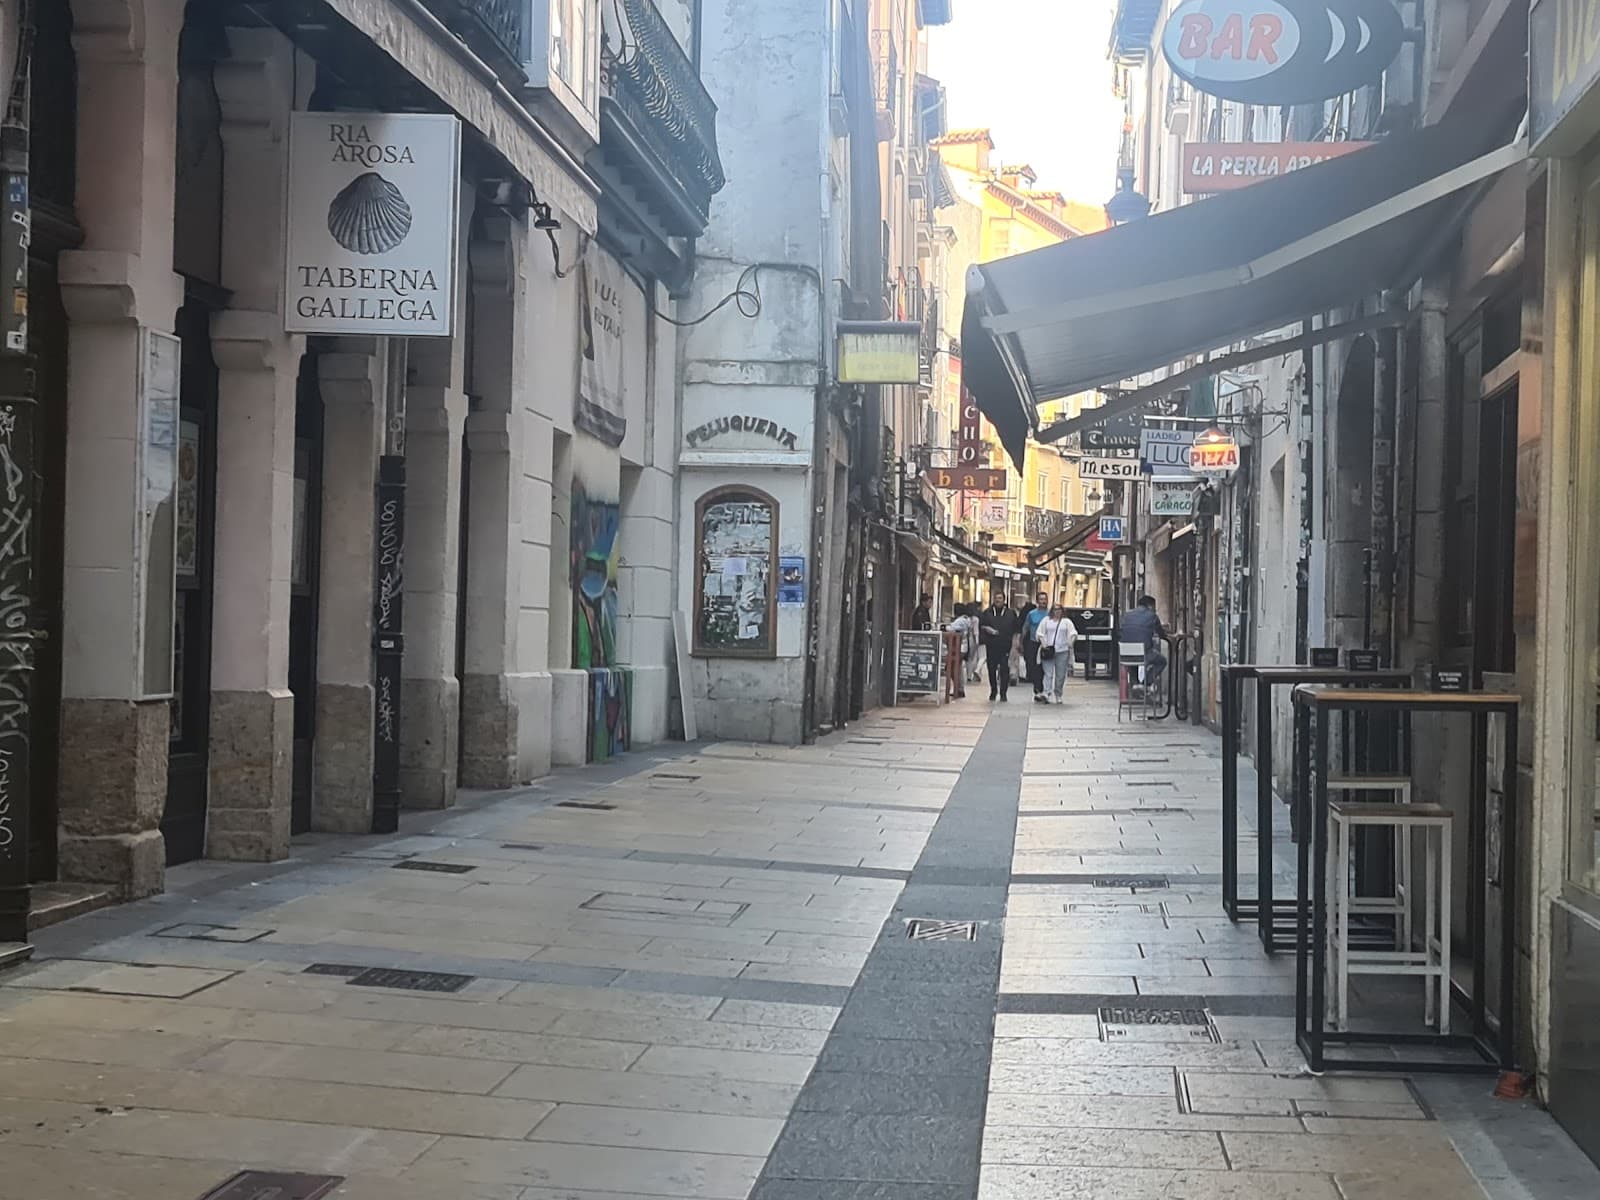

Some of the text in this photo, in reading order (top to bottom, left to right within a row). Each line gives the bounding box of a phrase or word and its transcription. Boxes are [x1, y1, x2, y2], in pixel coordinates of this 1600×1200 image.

[1178, 13, 1282, 64] BAR
[329, 124, 372, 147] RIA
[331, 144, 415, 167] AROSA
[1191, 155, 1213, 175] LA
[1220, 155, 1279, 176] PERLA
[298, 266, 438, 296] TABERNA
[296, 296, 438, 321] GALLEGA
[1190, 450, 1237, 467] PIZZA
[938, 470, 999, 488] bar
